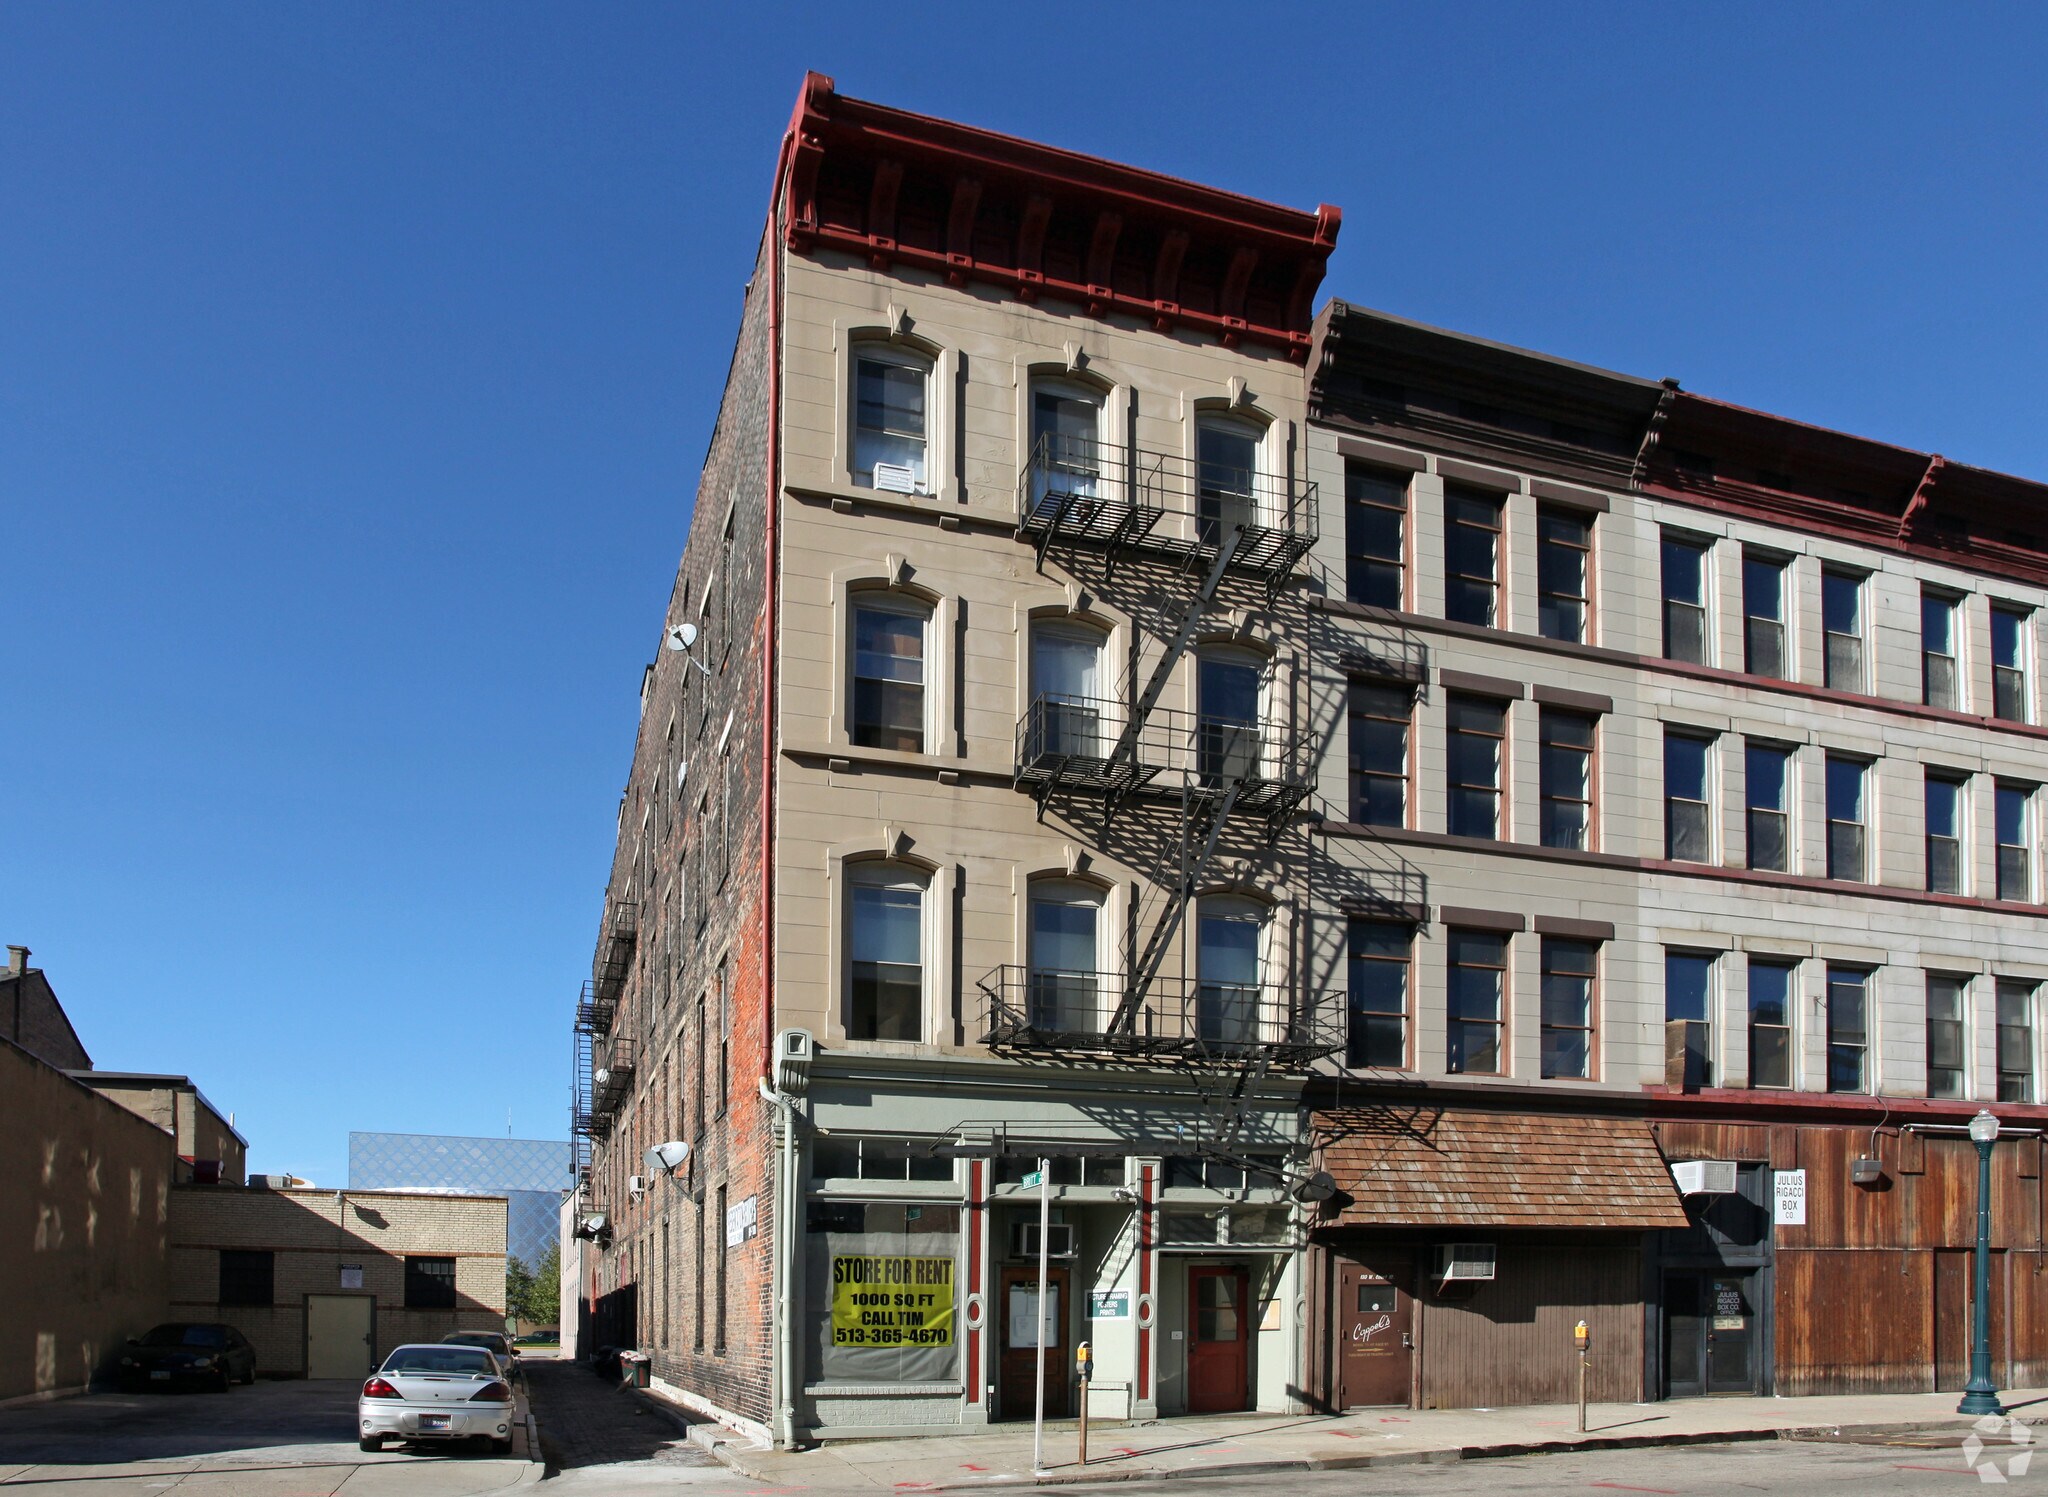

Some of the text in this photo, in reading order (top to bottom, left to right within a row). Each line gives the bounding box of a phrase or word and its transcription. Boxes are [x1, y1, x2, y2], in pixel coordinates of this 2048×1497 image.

[1777, 1175, 1803, 1186] JULIUS
[1776, 1187, 1804, 1198] RIGACCI
[1782, 1200, 1798, 1211] BOX
[834, 1257, 952, 1285] STORE FOR RENT
[851, 1293, 936, 1307] 1000 SQ FT
[862, 1311, 924, 1326] CALL TIM
[1353, 1314, 1391, 1342] Cappel's
[836, 1328, 948, 1343] 513-365-4670
